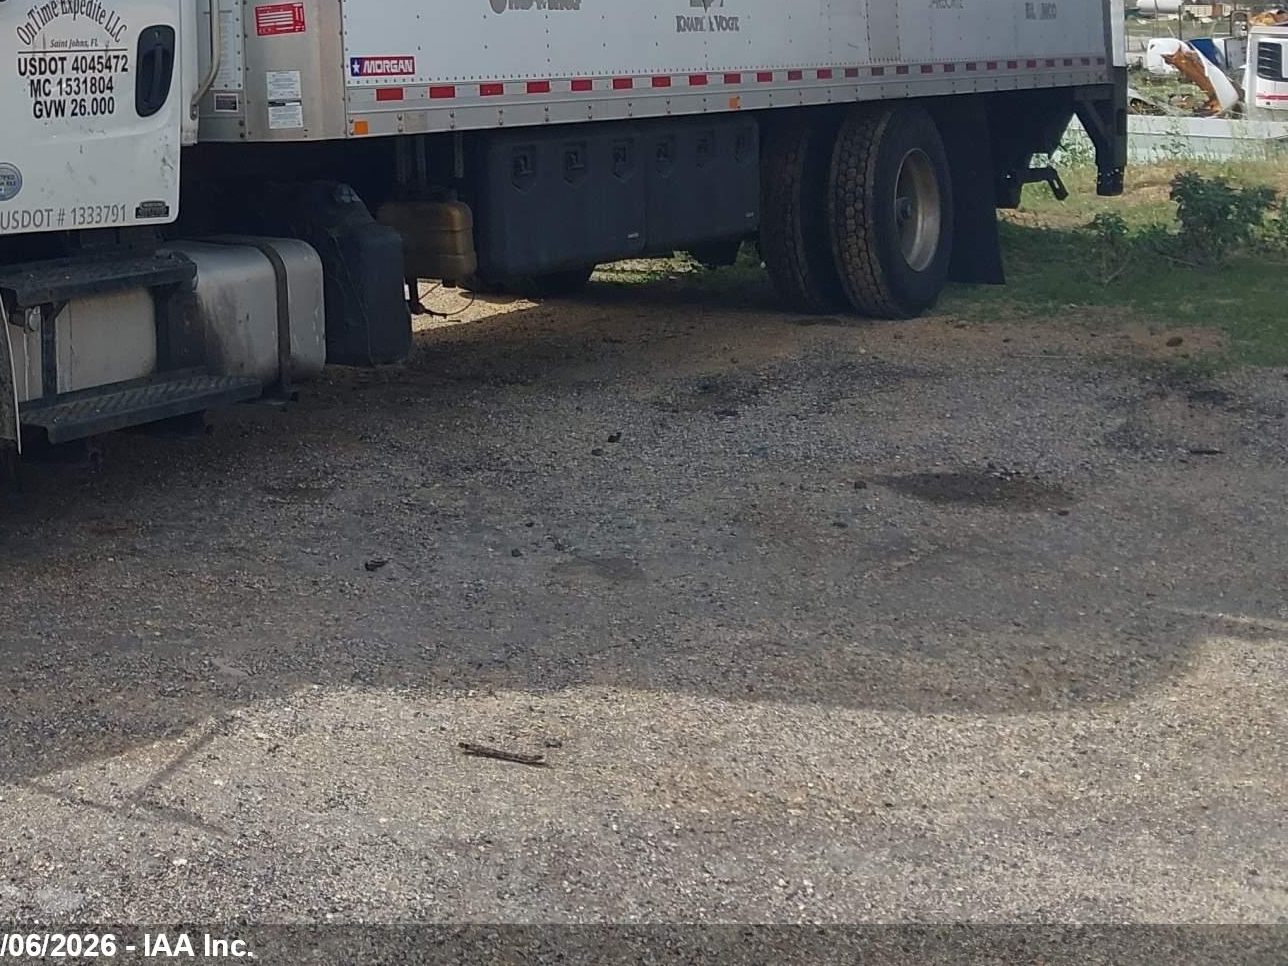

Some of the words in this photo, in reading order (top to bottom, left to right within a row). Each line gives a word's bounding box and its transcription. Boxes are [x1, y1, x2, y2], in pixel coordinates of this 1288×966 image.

[104, 10, 128, 43] LLC
[17, 56, 67, 76] USDOT
[71, 54, 128, 73] 4045472
[363, 60, 414, 74] MORGAN
[30, 78, 52, 98] MC
[56, 76, 114, 96] 1531804
[33, 99, 66, 119] GVW
[70, 96, 115, 117] 26.000
[0, 208, 54, 230] USDOT
[58, 207, 66, 226] #
[70, 203, 127, 226] 1333791
